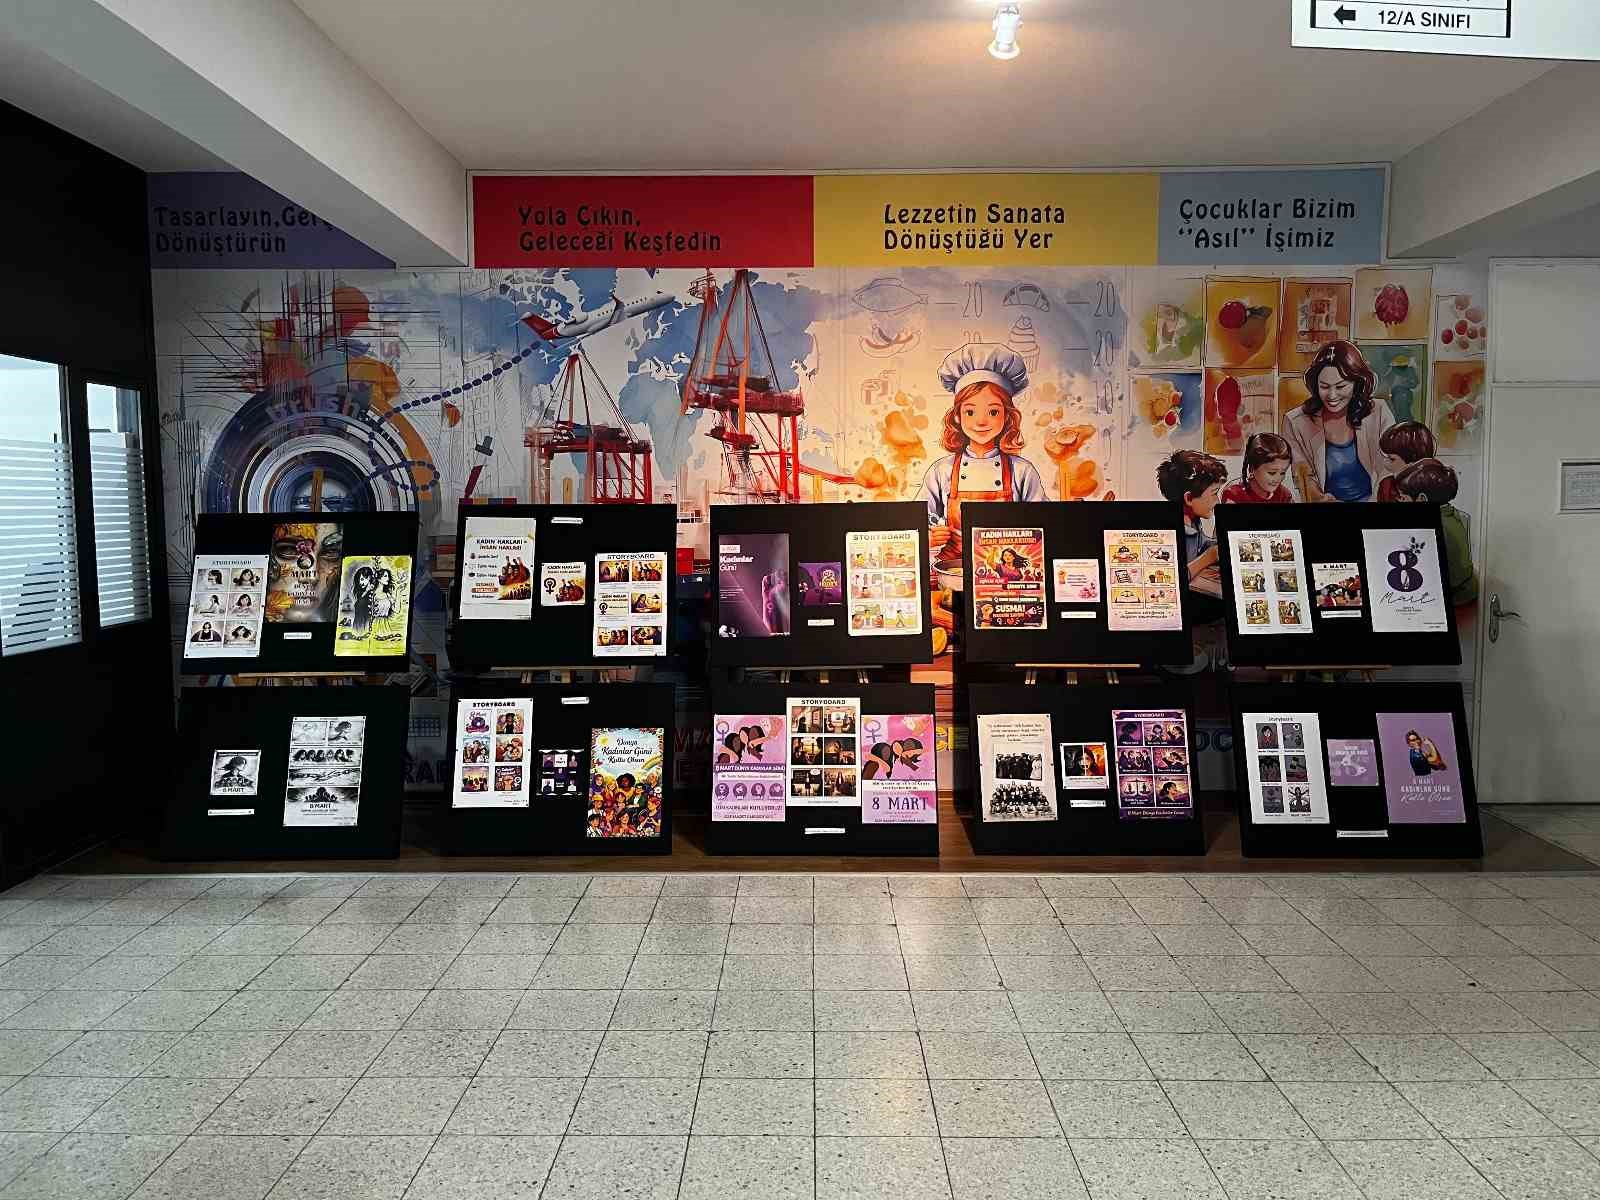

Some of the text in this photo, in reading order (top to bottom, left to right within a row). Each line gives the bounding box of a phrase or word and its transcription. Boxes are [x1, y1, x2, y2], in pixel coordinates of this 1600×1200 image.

[1378, 10, 1470, 29] 12/A SINIFI
[518, 206, 566, 226] Yola
[884, 203, 1065, 224] Lezzetin Sanata
[1180, 198, 1355, 224] Çocuklar Bizim
[155, 232, 286, 256] Dönüştürün
[519, 231, 721, 256] Geleceği Keşfedin
[884, 228, 1053, 254] Dönüştüğü Yer
[1265, 223, 1335, 253] İşimiz
[1387, 551, 1424, 592] 8
[995, 605, 1026, 613] SUSMA!
[872, 796, 929, 810] 8 MART
